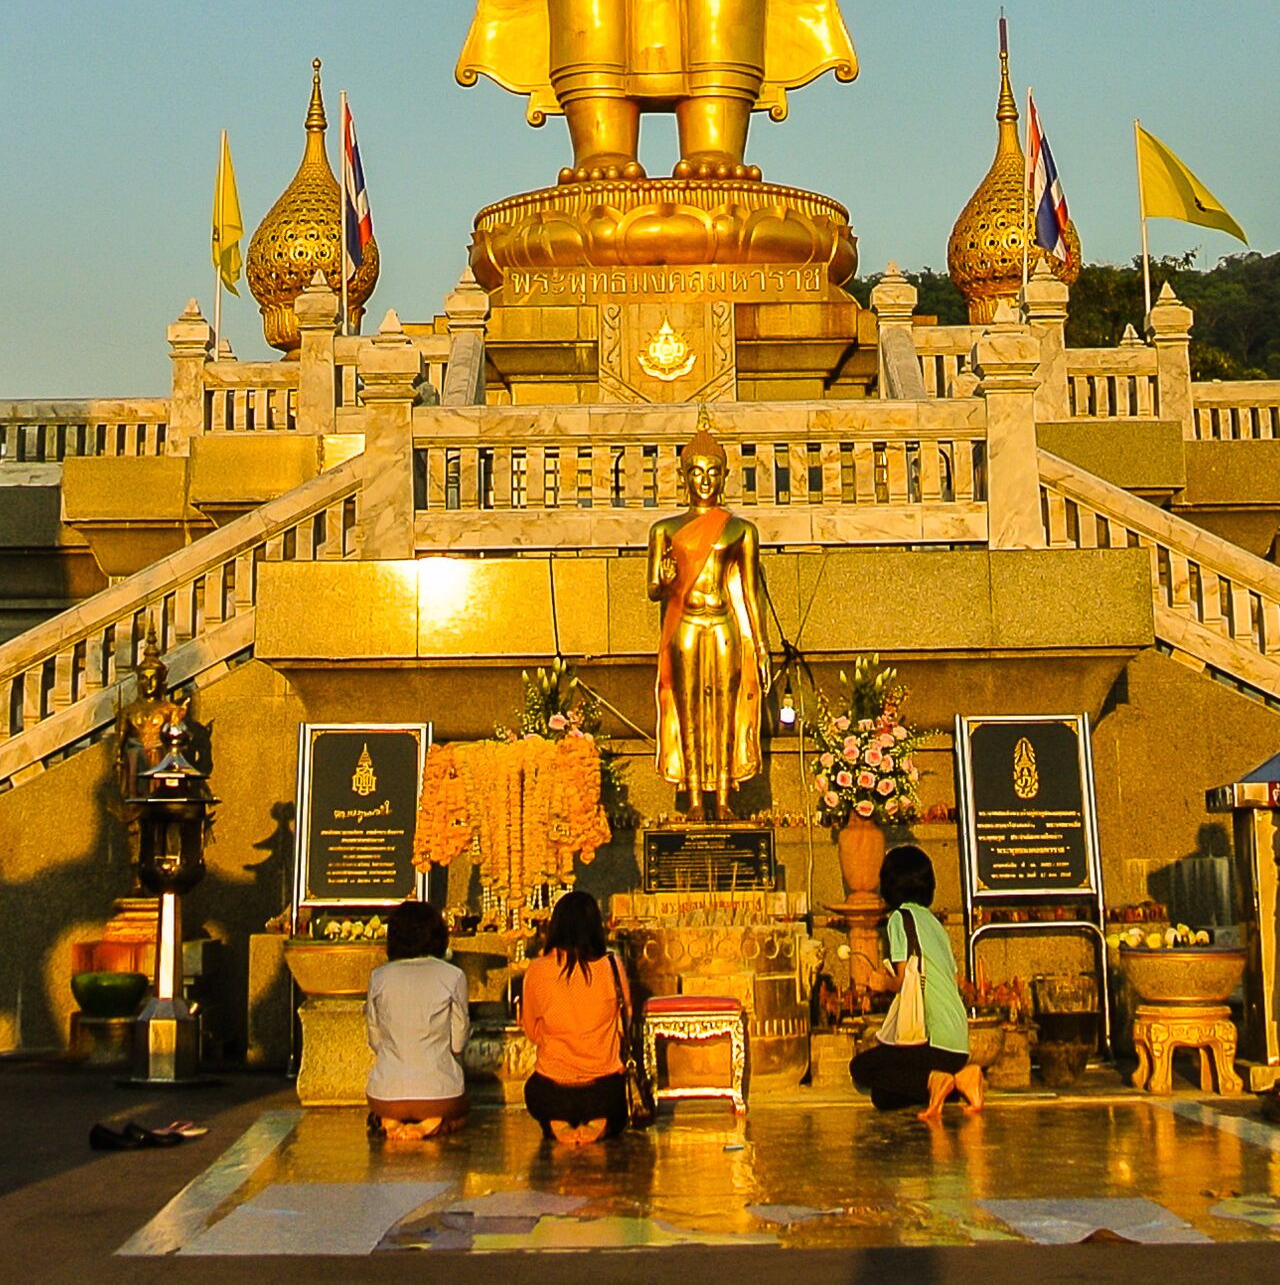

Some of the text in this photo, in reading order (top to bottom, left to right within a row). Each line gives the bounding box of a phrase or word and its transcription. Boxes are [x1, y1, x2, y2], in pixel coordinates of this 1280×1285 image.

[511, 268, 821, 304] พระพุทธมงคลมหาราช
